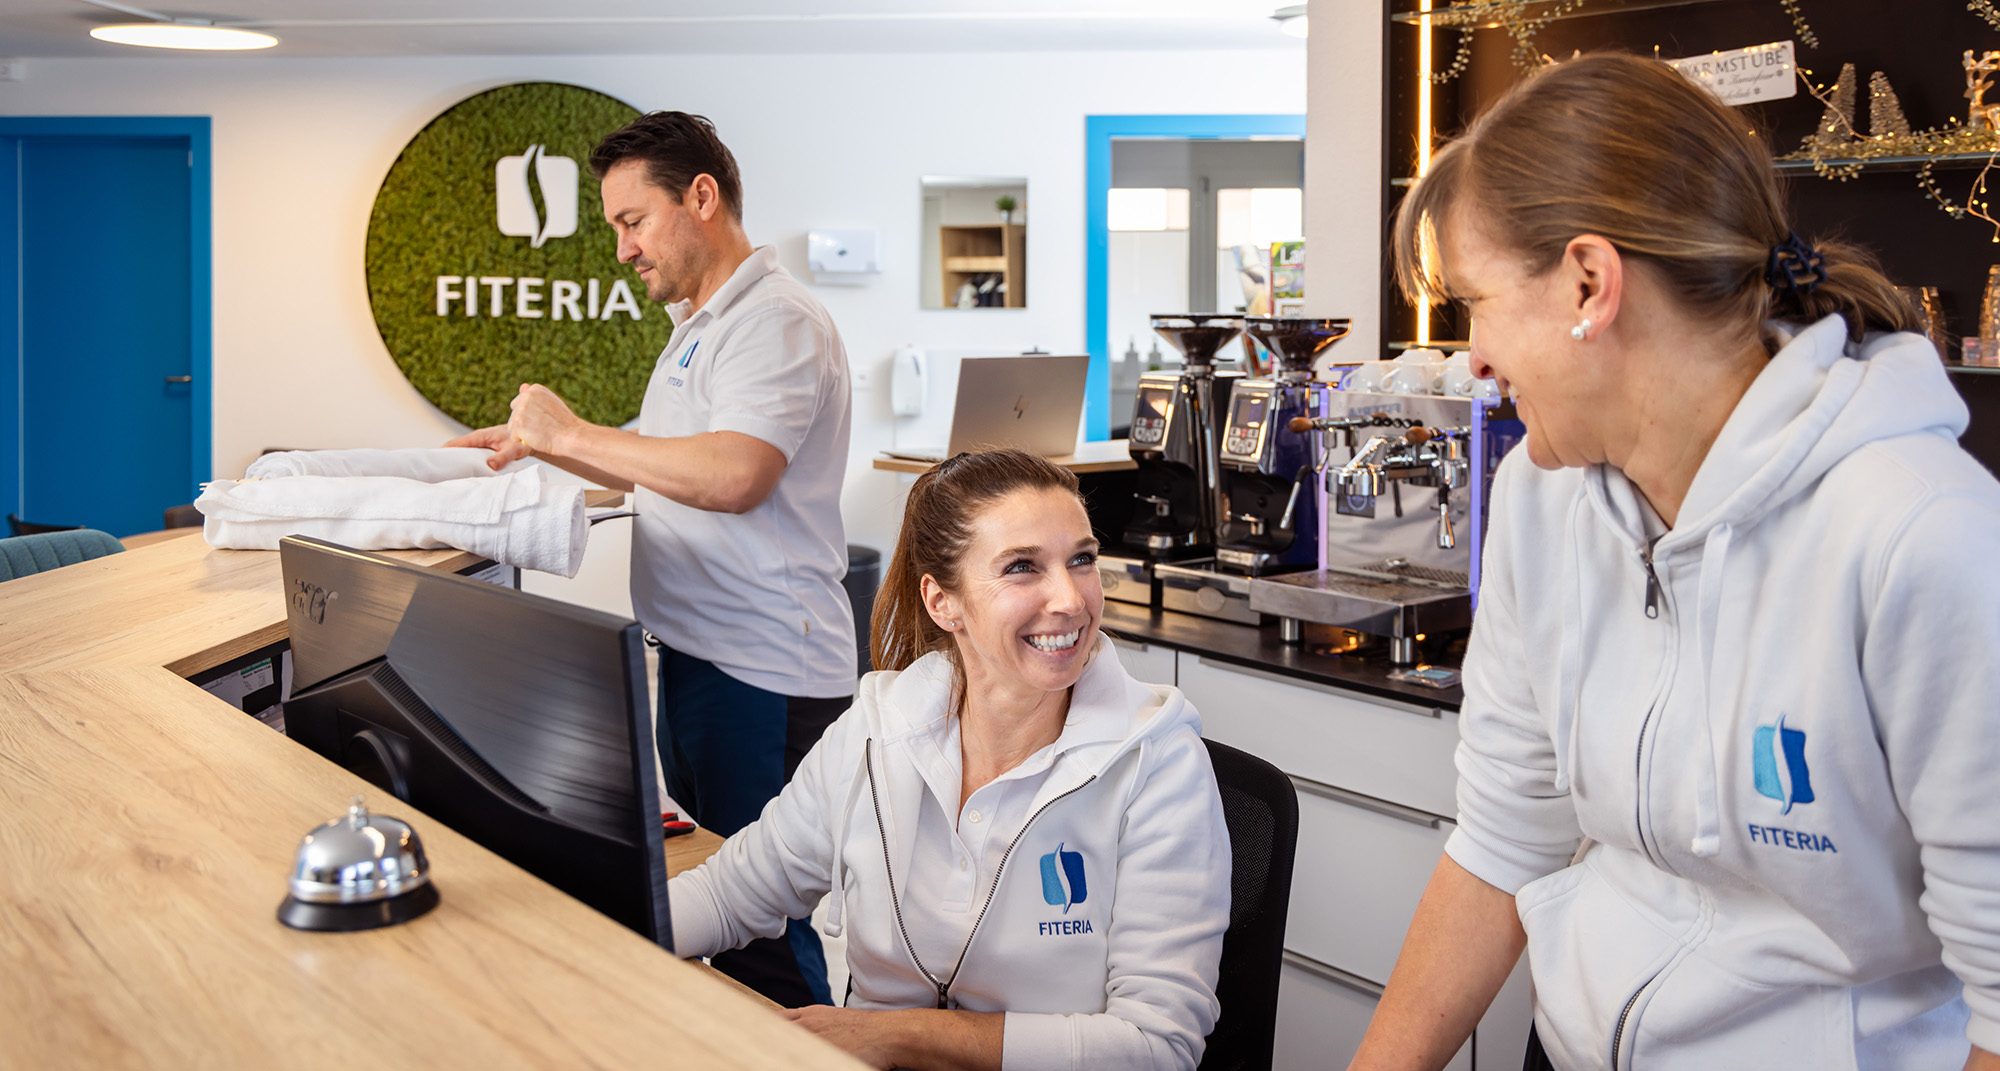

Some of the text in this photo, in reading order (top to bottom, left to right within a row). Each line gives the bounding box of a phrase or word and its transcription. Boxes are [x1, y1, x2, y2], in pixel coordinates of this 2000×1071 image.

[436, 275, 643, 322] FITERIA
[1747, 823, 1838, 854] FITERIA
[1039, 919, 1094, 936] FITERIA
